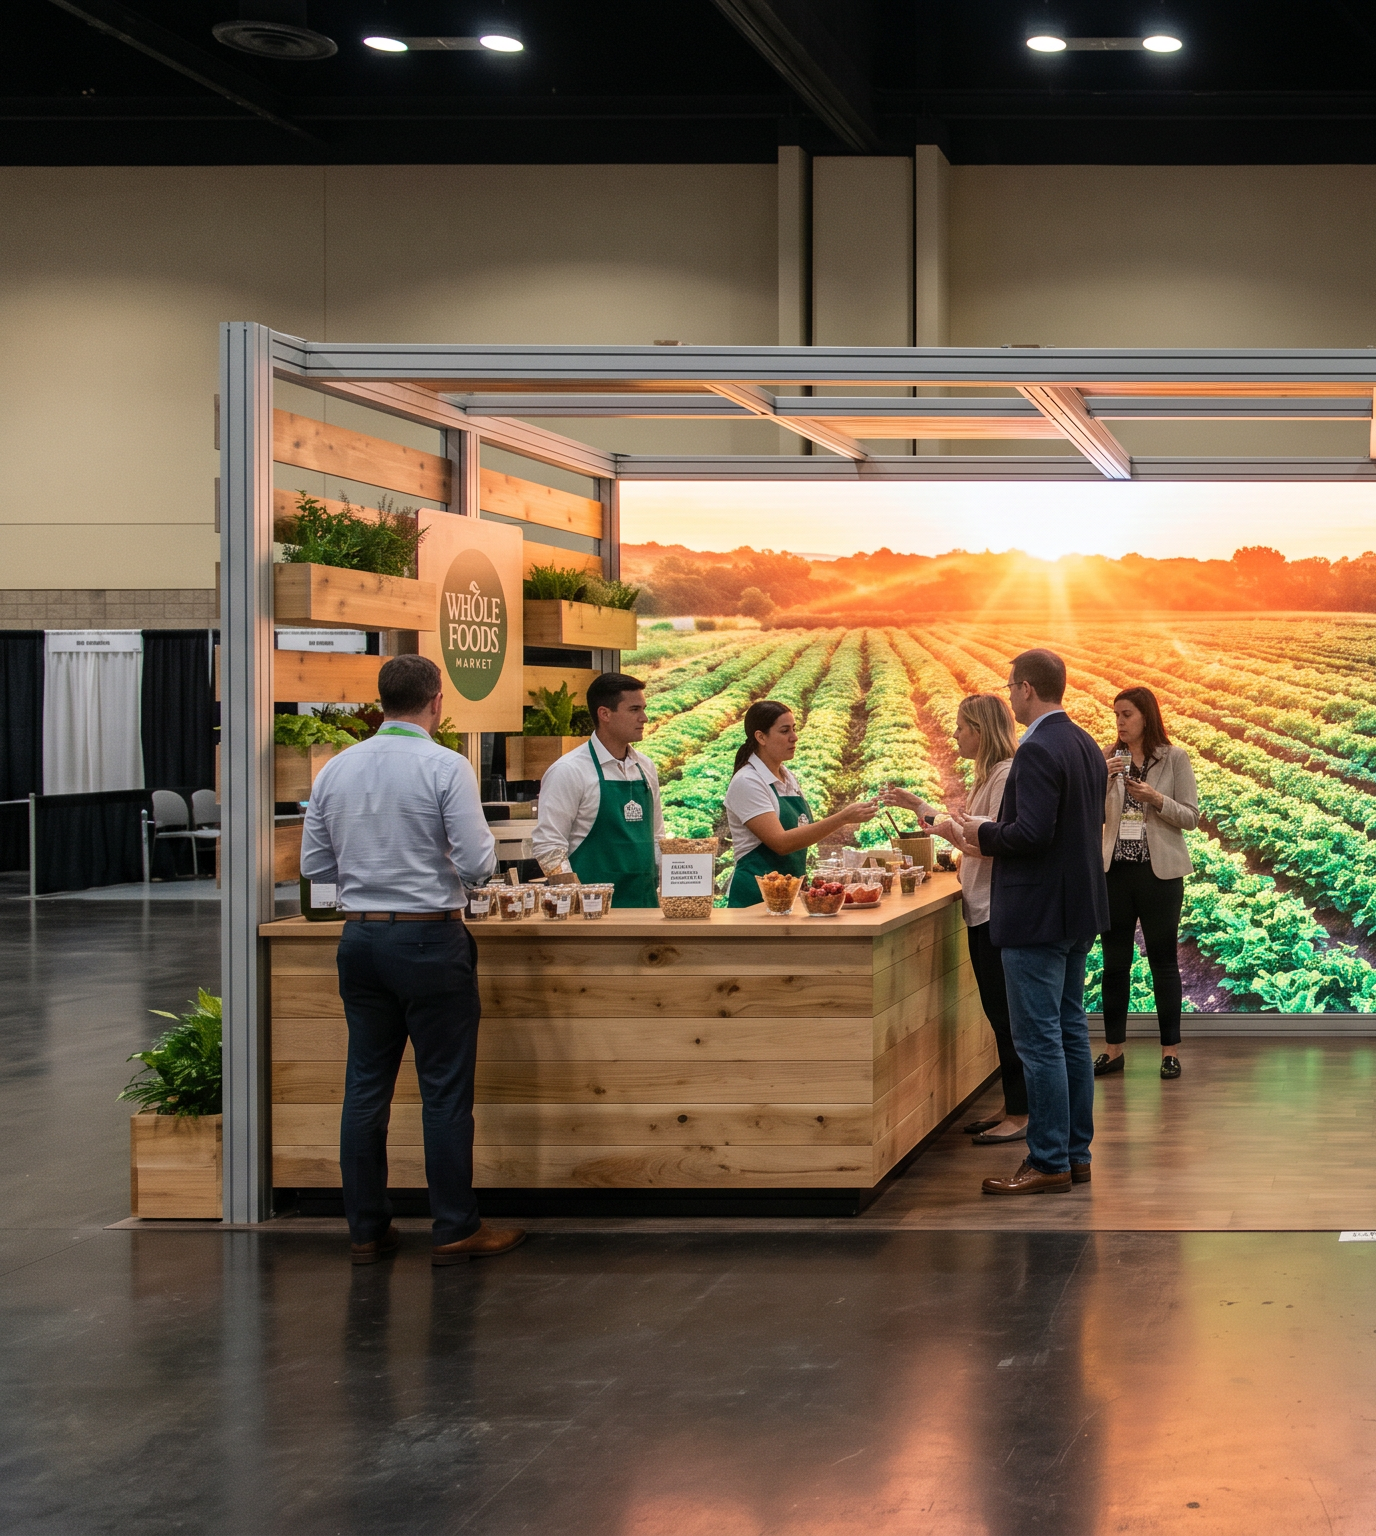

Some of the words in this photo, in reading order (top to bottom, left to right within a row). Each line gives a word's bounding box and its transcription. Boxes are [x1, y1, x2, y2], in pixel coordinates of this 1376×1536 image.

[445, 592, 500, 623] WHOLE
[448, 624, 499, 653] FOODS
[455, 657, 492, 670] MARKET
